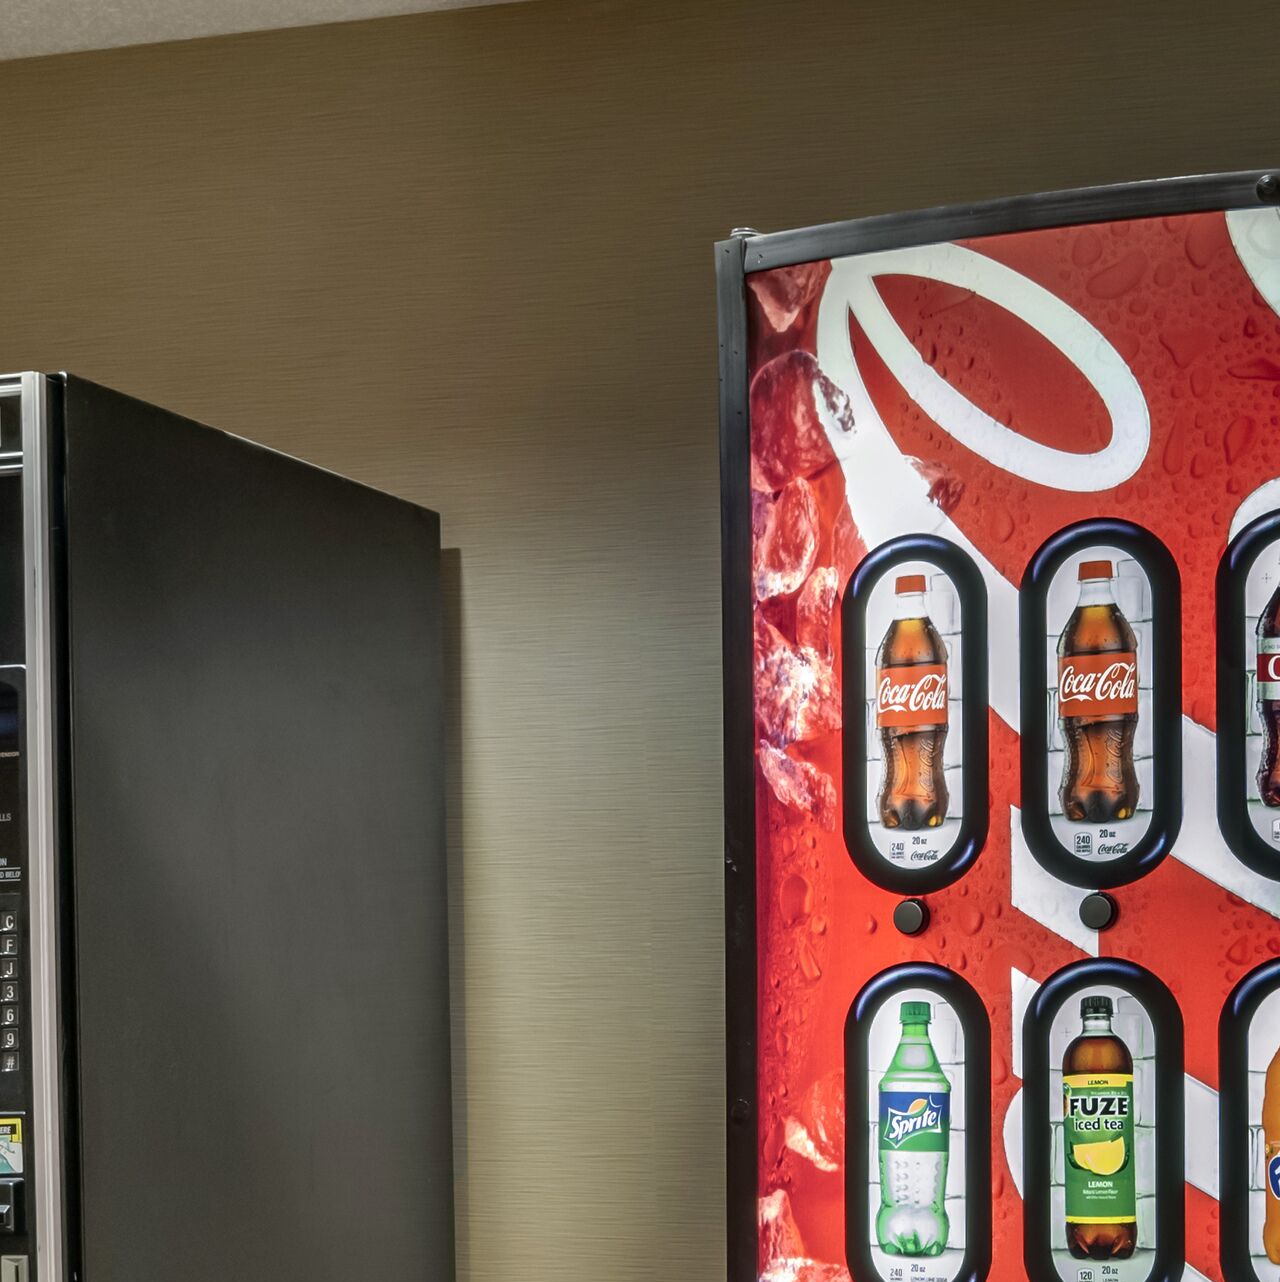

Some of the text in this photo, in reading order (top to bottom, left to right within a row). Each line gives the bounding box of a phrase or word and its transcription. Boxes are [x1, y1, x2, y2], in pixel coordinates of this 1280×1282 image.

[1060, 662, 1136, 702] Coca-Cola
[878, 673, 946, 713] Coca-Cola
[1076, 835, 1090, 844] 240
[1099, 829, 1108, 838] 20
[891, 843, 904, 851] 240
[1098, 843, 1129, 855] Coca-Cola
[1069, 1097, 1129, 1117] FUZE
[888, 1110, 939, 1139] Sprite
[1075, 1118, 1124, 1131] iced tea
[1080, 1271, 1093, 1280] 120
